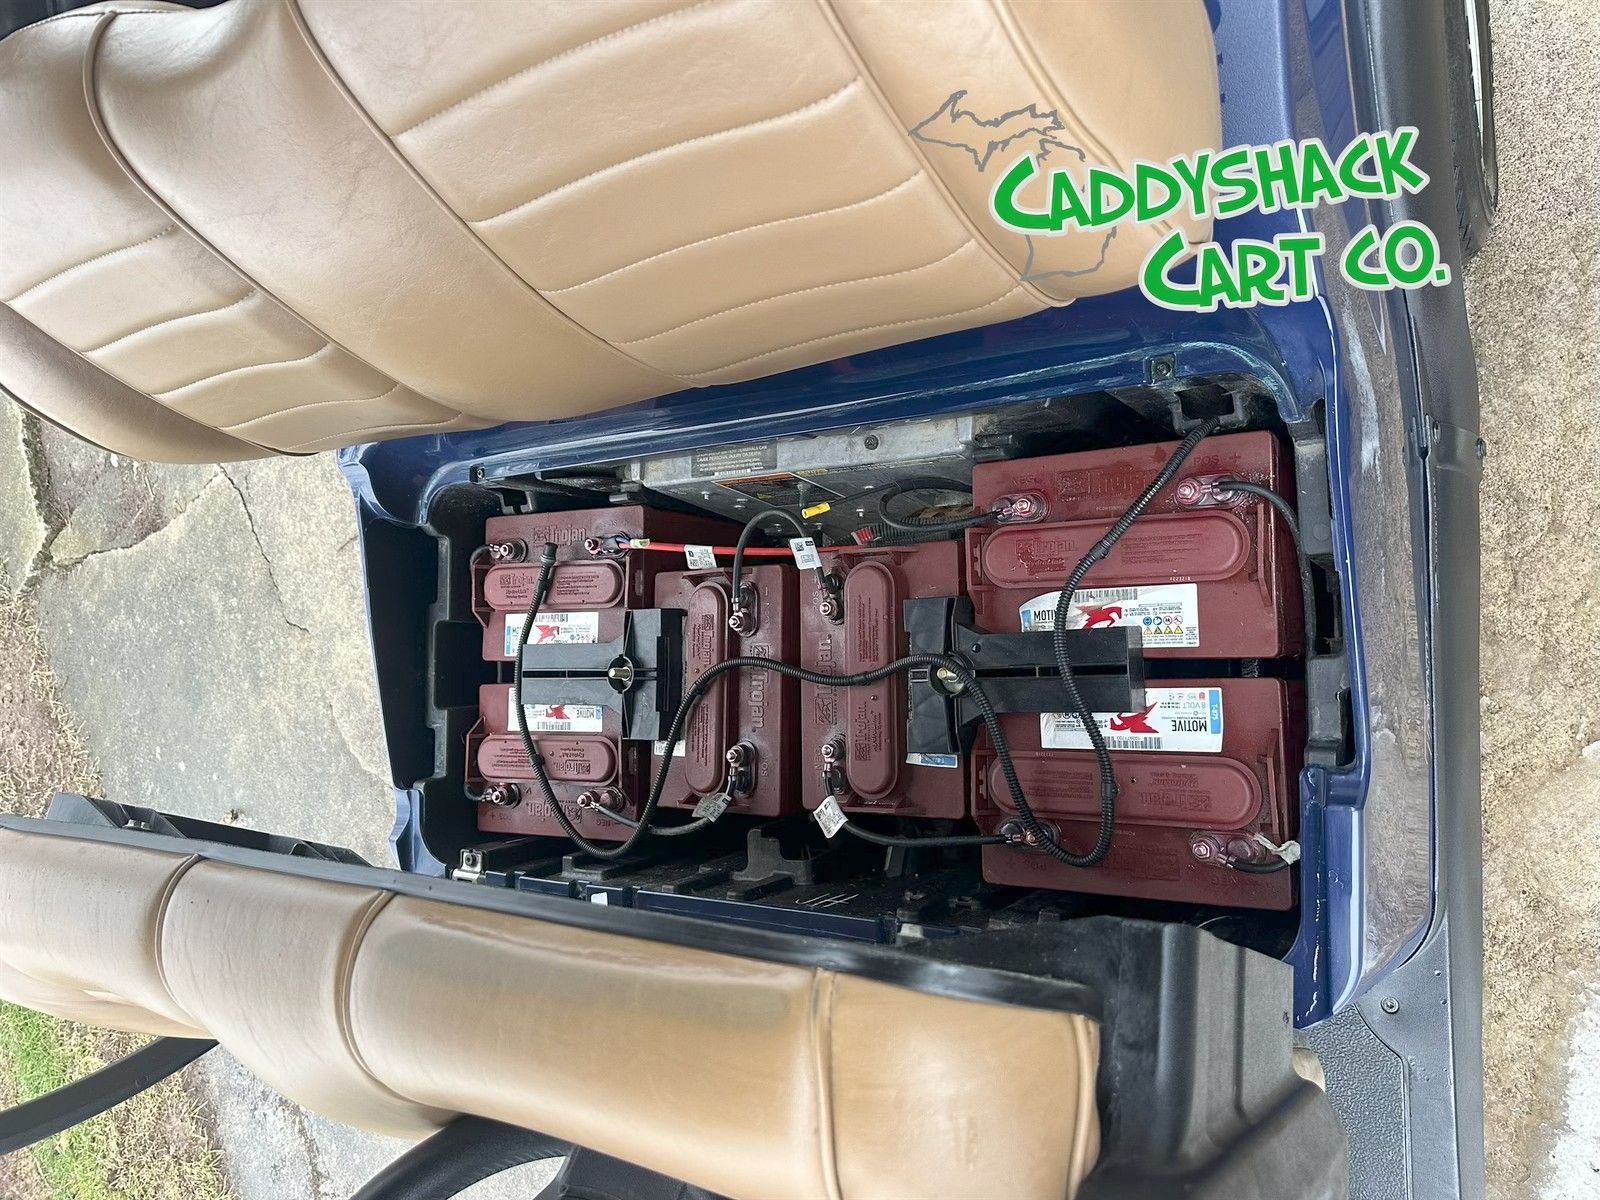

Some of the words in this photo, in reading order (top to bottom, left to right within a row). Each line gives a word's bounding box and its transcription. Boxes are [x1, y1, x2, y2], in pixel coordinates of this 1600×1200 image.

[1033, 609, 1057, 621] MOTI
[814, 638, 837, 698] Tojan
[1171, 720, 1207, 732] MOTIVE
[528, 799, 569, 822] Tojan
